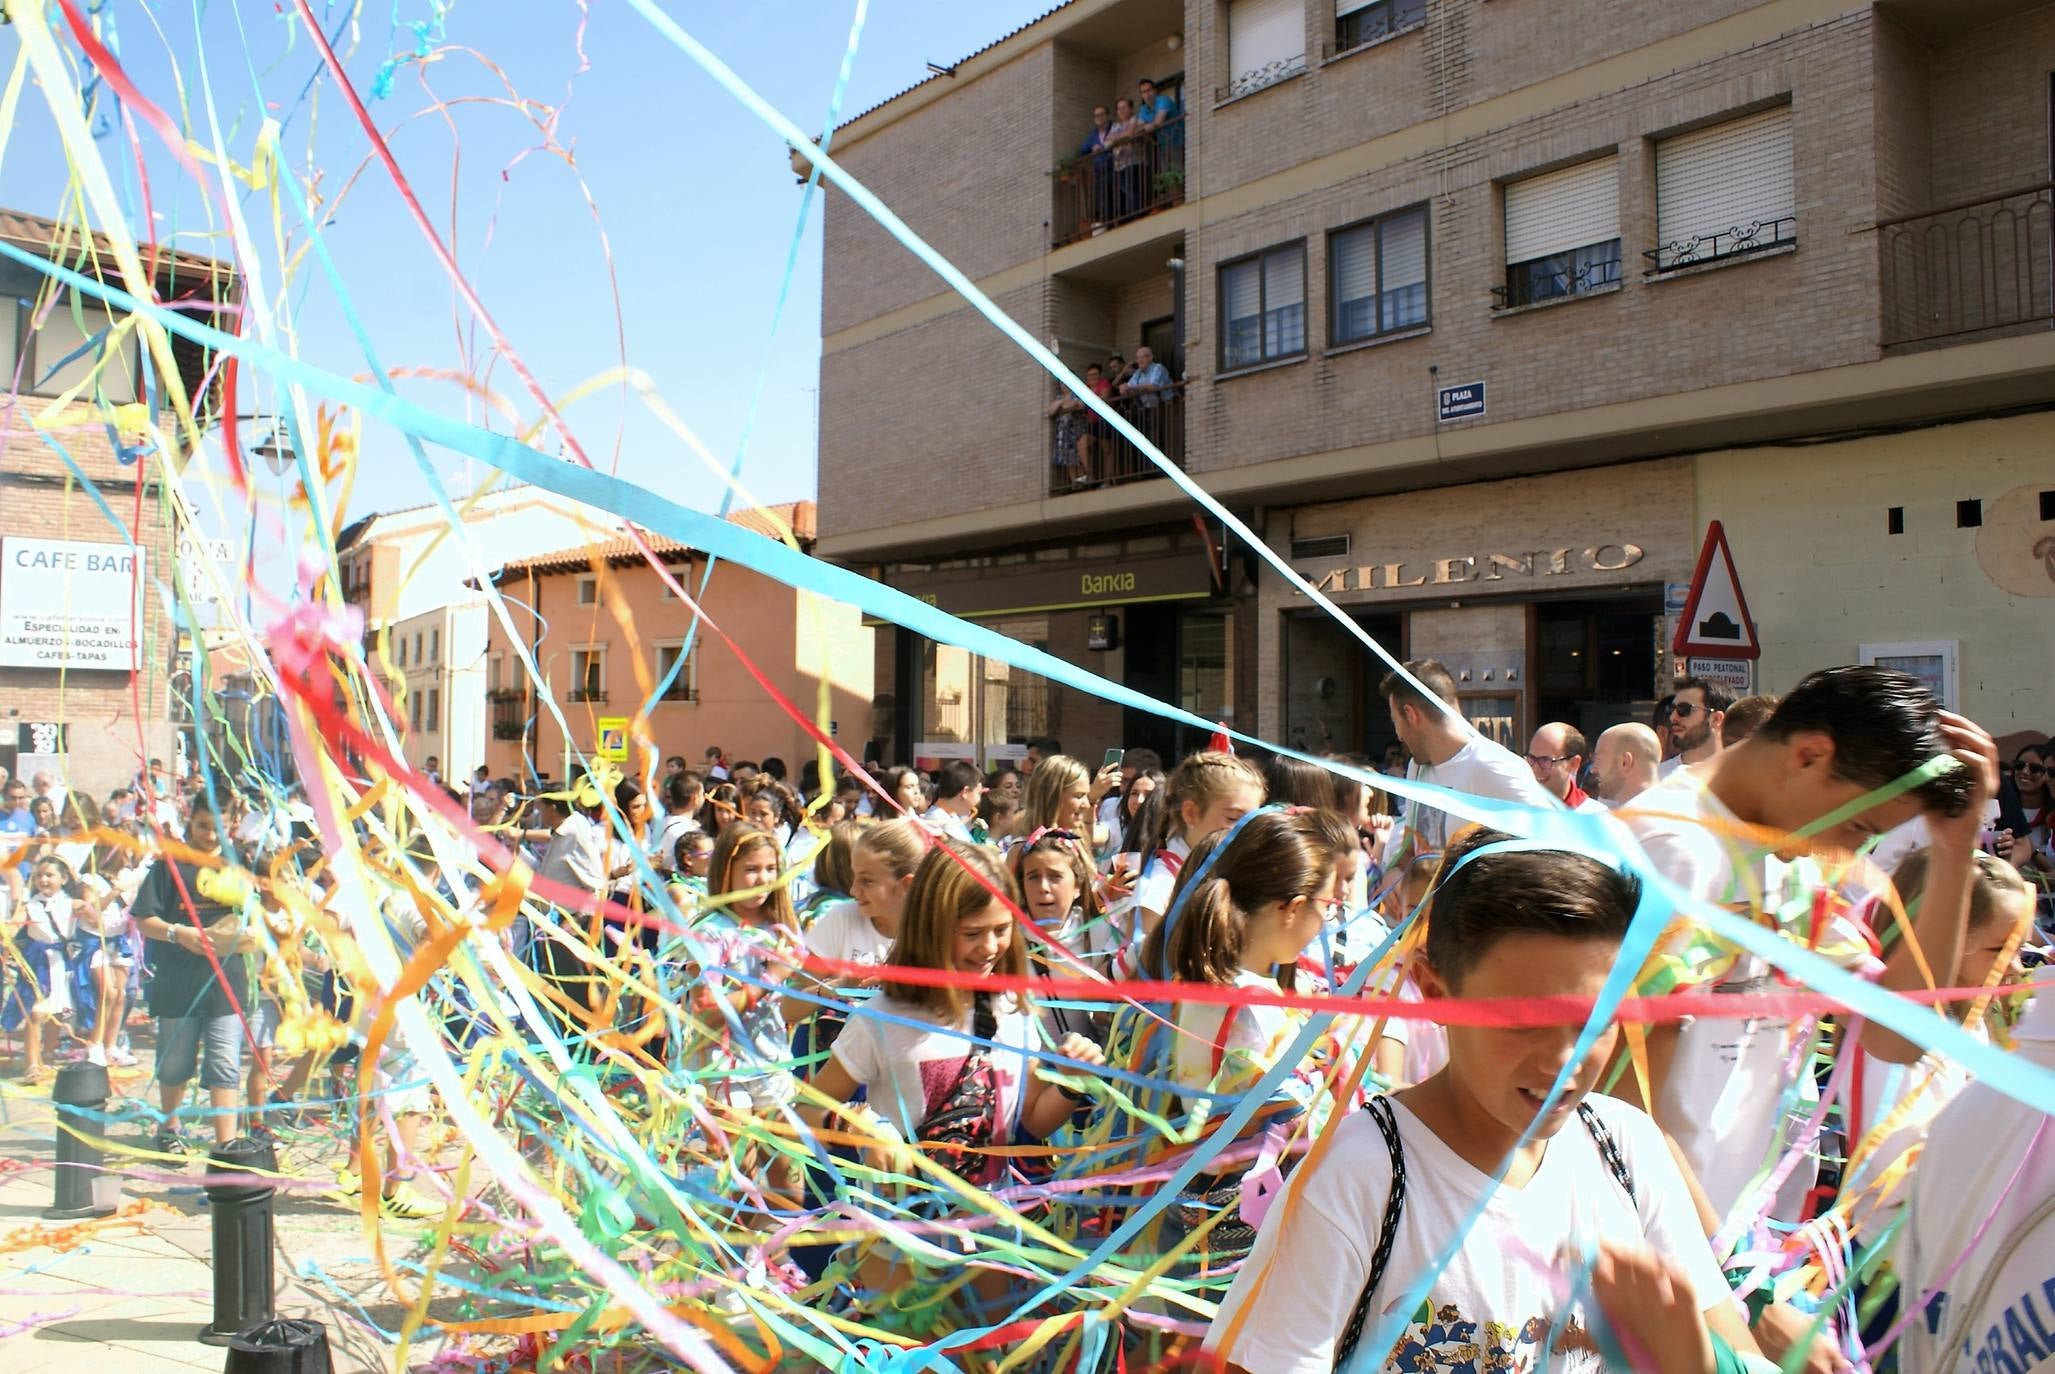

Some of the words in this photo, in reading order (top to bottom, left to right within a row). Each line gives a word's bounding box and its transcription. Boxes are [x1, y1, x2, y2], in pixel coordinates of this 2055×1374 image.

[1452, 390, 1472, 401] PLAZA
[87, 554, 133, 573] BAR
[1293, 543, 1645, 596] MILENIO
[1081, 572, 1135, 595] Bankia
[24, 621, 99, 634] ESPECILIDAD
[1693, 662, 1710, 672] PASO
[1714, 663, 1746, 673] PEATONAL
